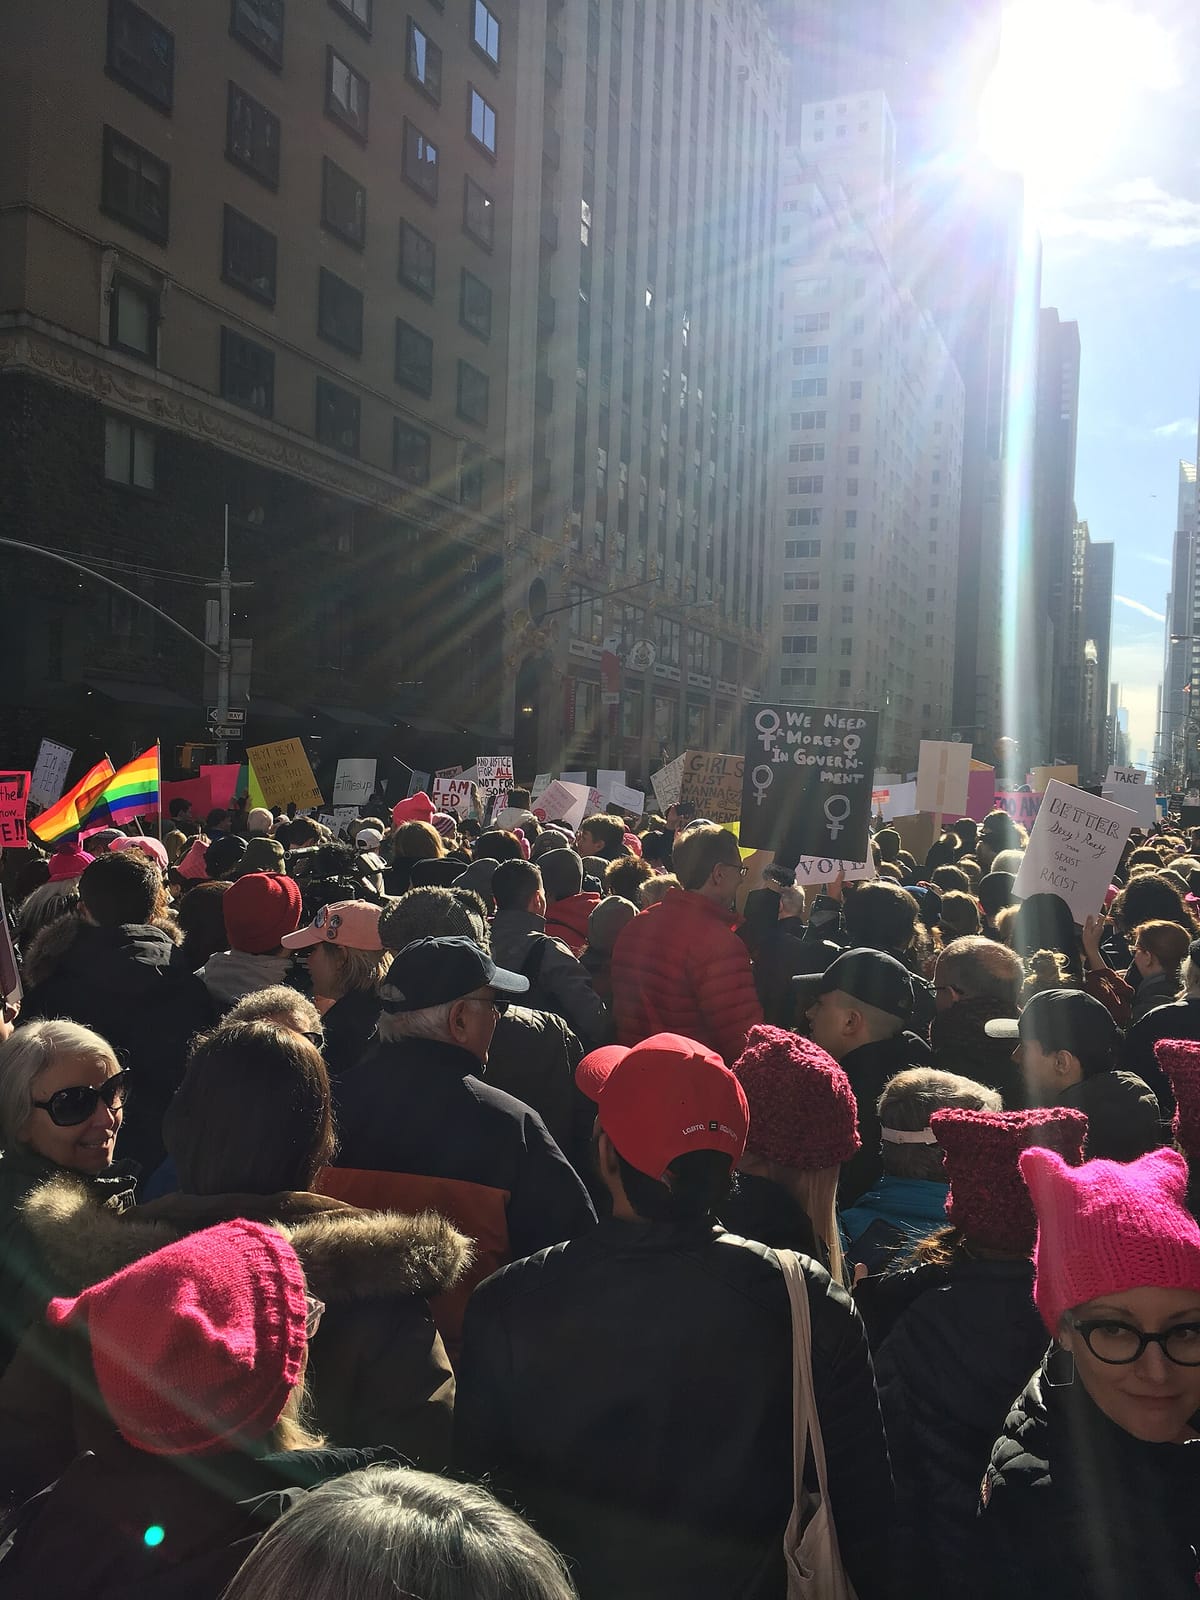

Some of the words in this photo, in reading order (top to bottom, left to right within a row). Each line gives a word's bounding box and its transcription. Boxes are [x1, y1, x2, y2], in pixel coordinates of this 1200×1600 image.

[786, 711, 812, 728] WE
[824, 713, 866, 731] NEED
[786, 730, 835, 747] MORE
[771, 745, 789, 763] IN
[793, 748, 864, 769] GOVERN-
[478, 766, 493, 777] FOR
[496, 767, 512, 776] ALL
[690, 755, 744, 777] GIRLS
[478, 779, 496, 788] NOT
[499, 779, 514, 788] FOR
[684, 772, 725, 786] JUST
[819, 770, 865, 785] MENT
[1113, 770, 1142, 785] TAKE
[436, 779, 440, 791] I
[449, 780, 470, 795] AM
[485, 788, 506, 796] SOM
[432, 792, 460, 807] FED
[1049, 797, 1120, 840] BETTER
[1053, 850, 1081, 868] SEXIST
[1039, 867, 1079, 892] RACIST
